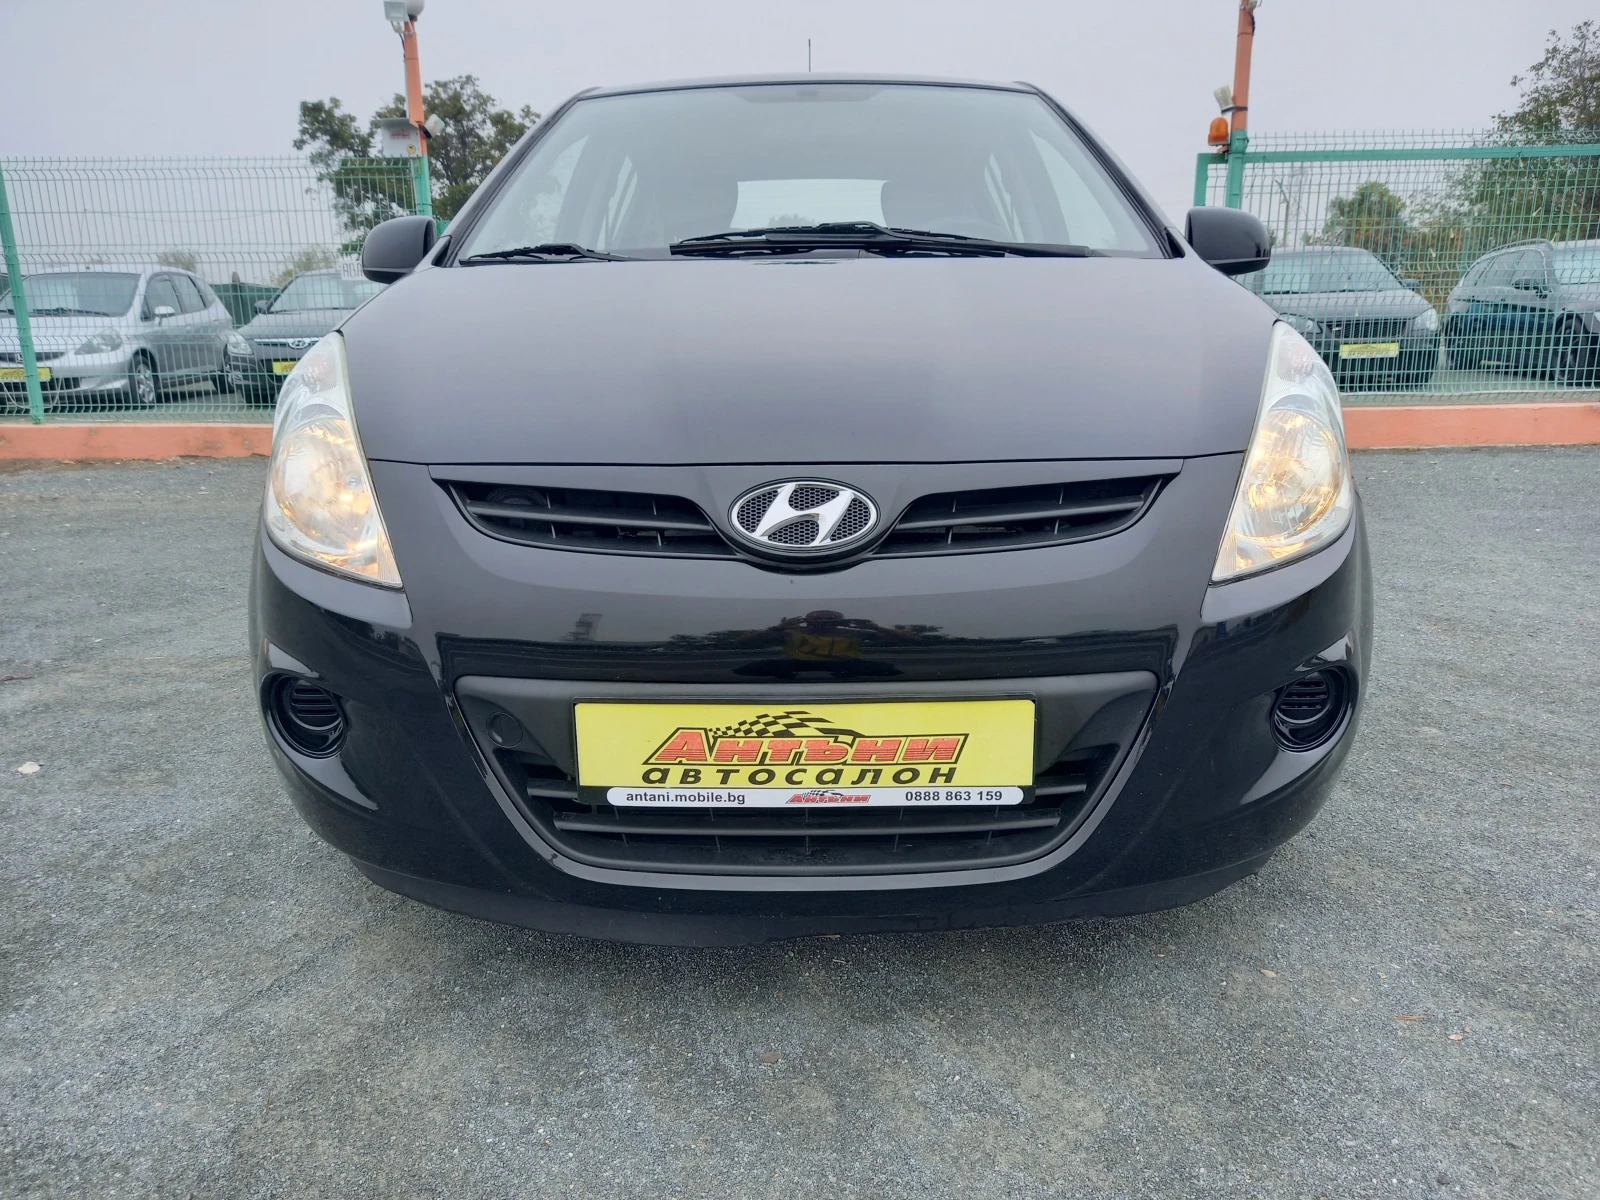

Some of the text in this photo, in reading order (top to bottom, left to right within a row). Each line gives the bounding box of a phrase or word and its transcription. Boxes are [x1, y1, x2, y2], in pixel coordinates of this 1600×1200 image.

[641, 767, 957, 786] автосалон
[626, 791, 746, 805] antani.mobile.bg
[905, 790, 1003, 802] 0888 863 159
